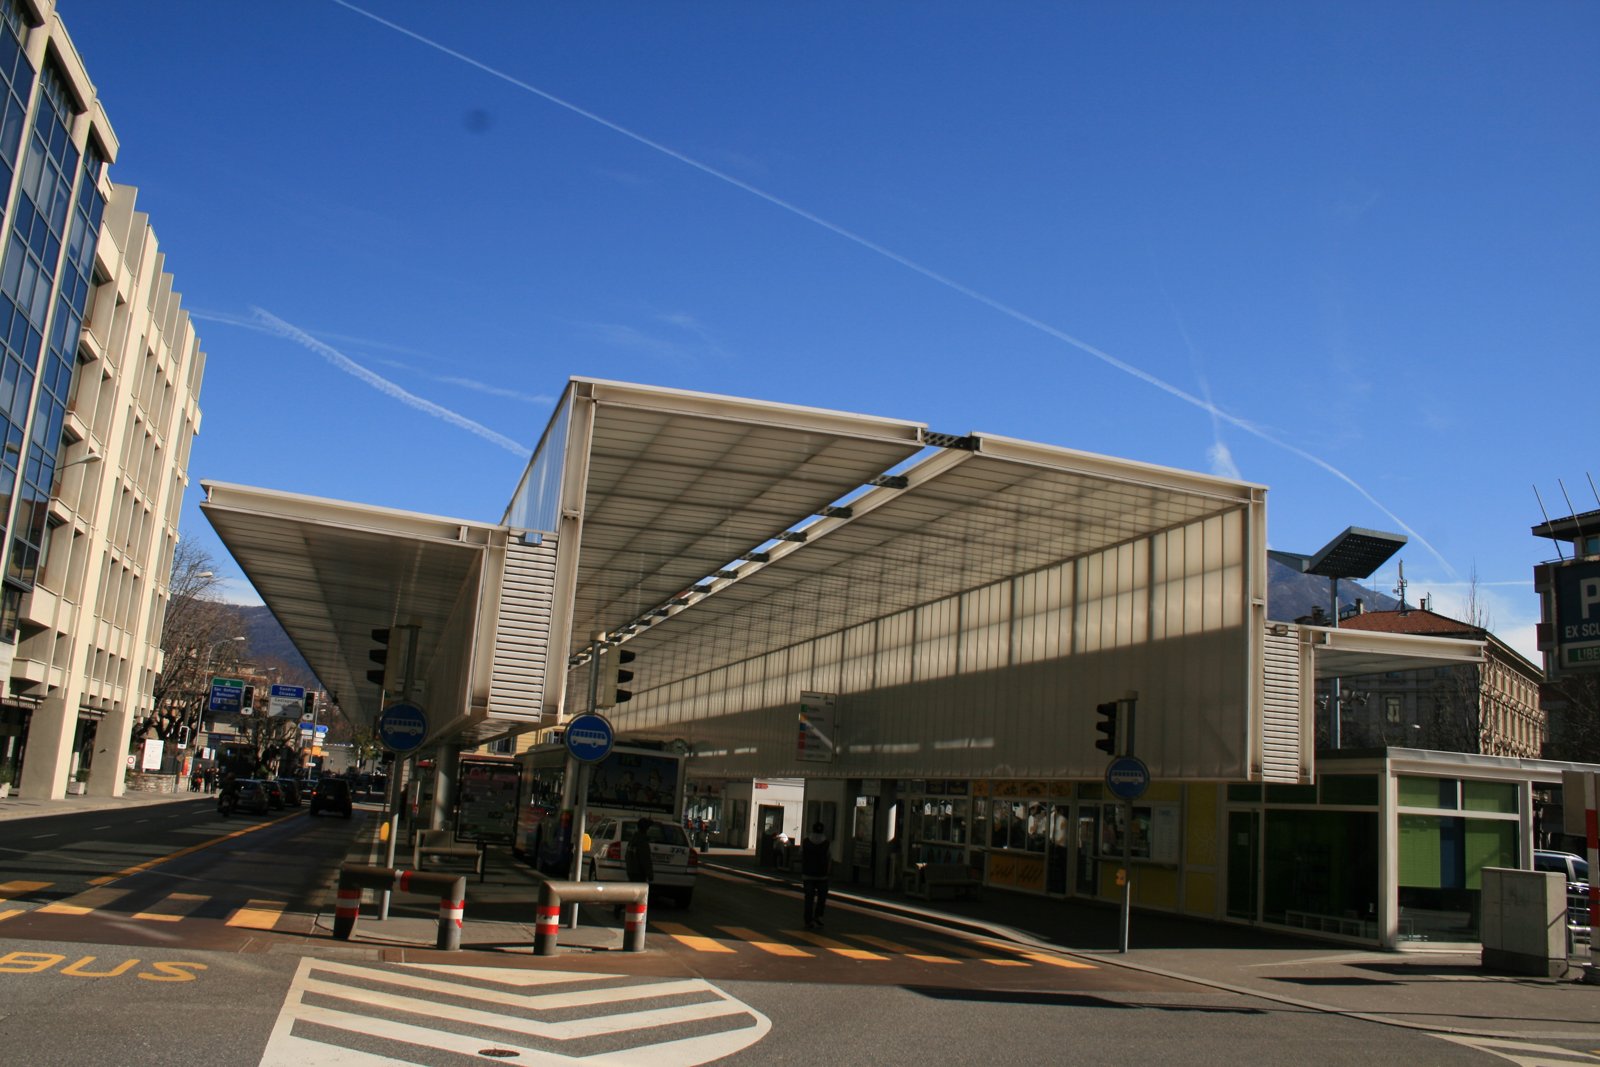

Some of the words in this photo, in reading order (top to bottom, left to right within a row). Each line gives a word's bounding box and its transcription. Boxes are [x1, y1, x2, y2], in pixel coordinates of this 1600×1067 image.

[1565, 625, 1579, 638] EX
[1578, 647, 1600, 661] LIBE
[0, 951, 208, 982] BUS
